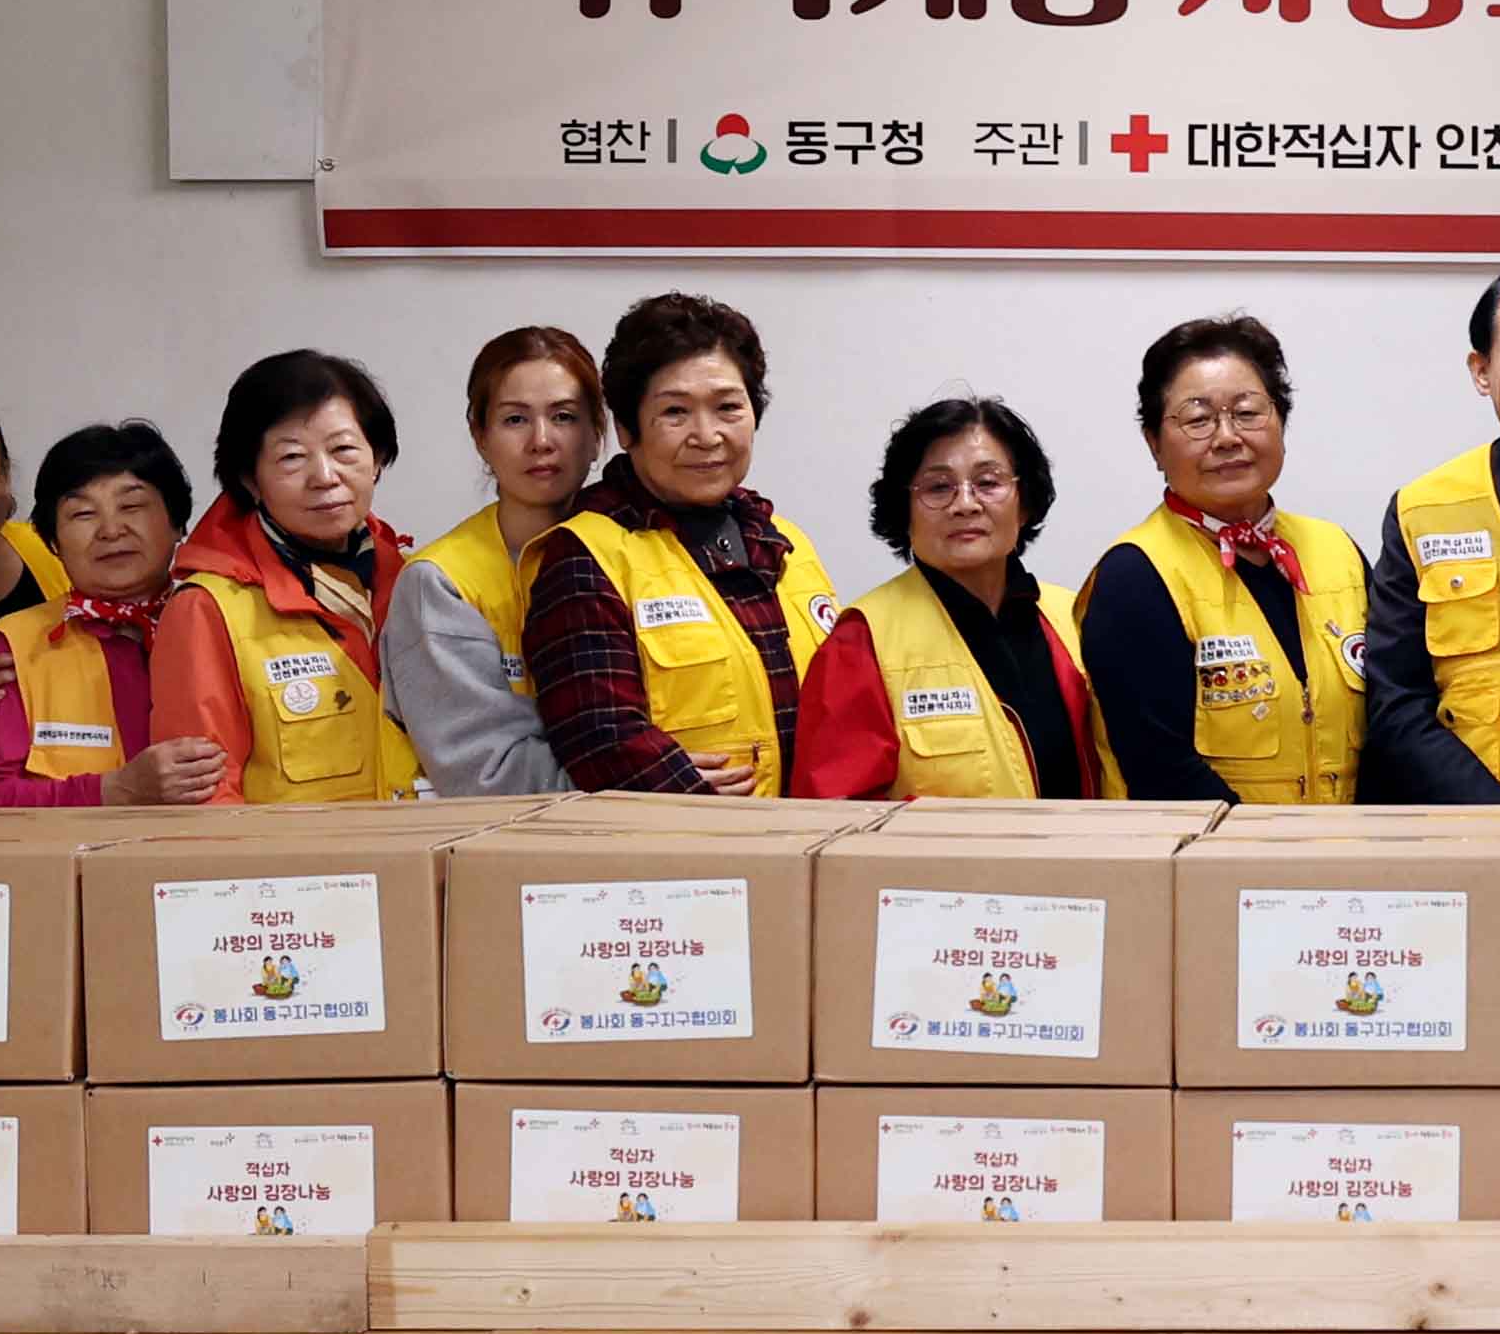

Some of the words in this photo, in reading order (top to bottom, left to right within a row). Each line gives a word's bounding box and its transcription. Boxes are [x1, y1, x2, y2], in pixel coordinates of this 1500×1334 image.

[560, 118, 651, 165] 협찬
[785, 119, 925, 165] 동구청
[973, 120, 1064, 166] 주관
[1187, 123, 1420, 170] 대한적십자
[618, 917, 666, 936] 적십자
[579, 940, 632, 961] 사랑의
[636, 938, 707, 960] 김장나눔
